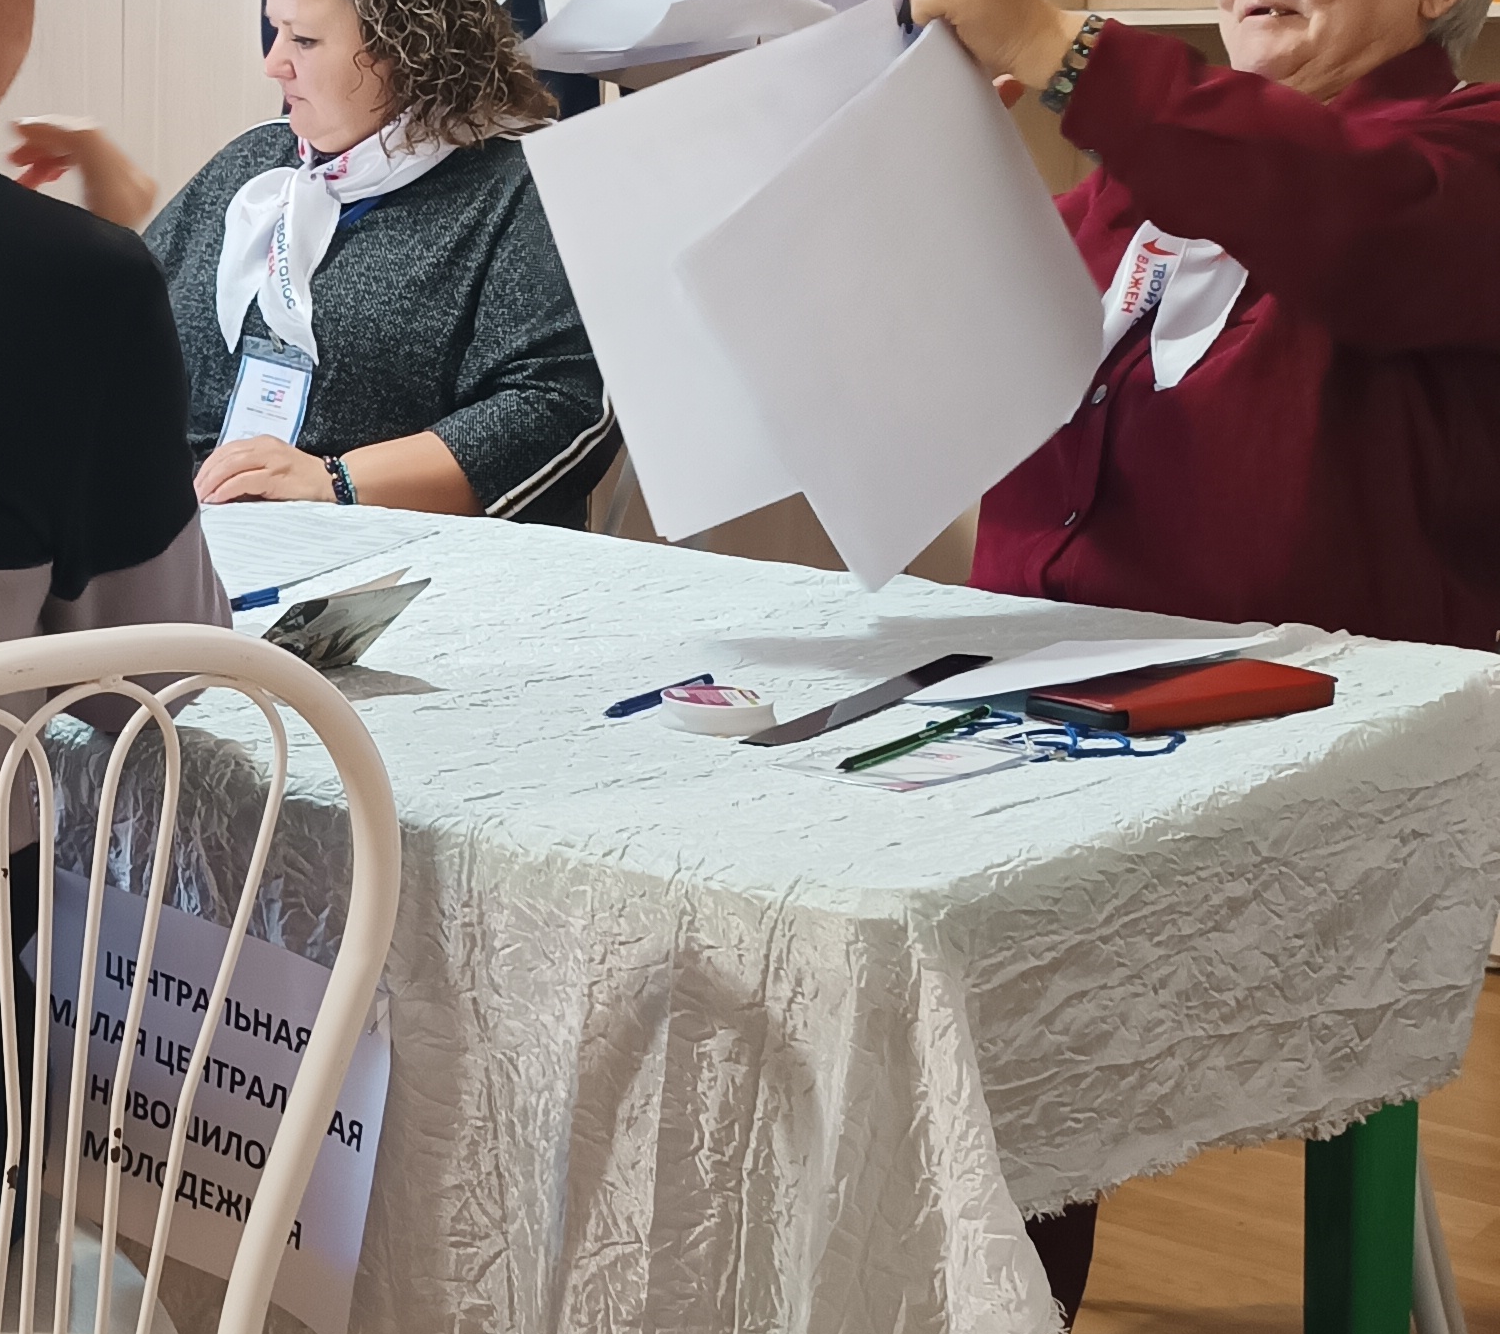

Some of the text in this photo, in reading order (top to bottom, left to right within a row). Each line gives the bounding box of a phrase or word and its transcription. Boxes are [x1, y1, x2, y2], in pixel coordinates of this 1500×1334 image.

[276, 213, 296, 309] ТВОЙ ГОЛОС
[1121, 253, 1150, 314] ВАЖЕН
